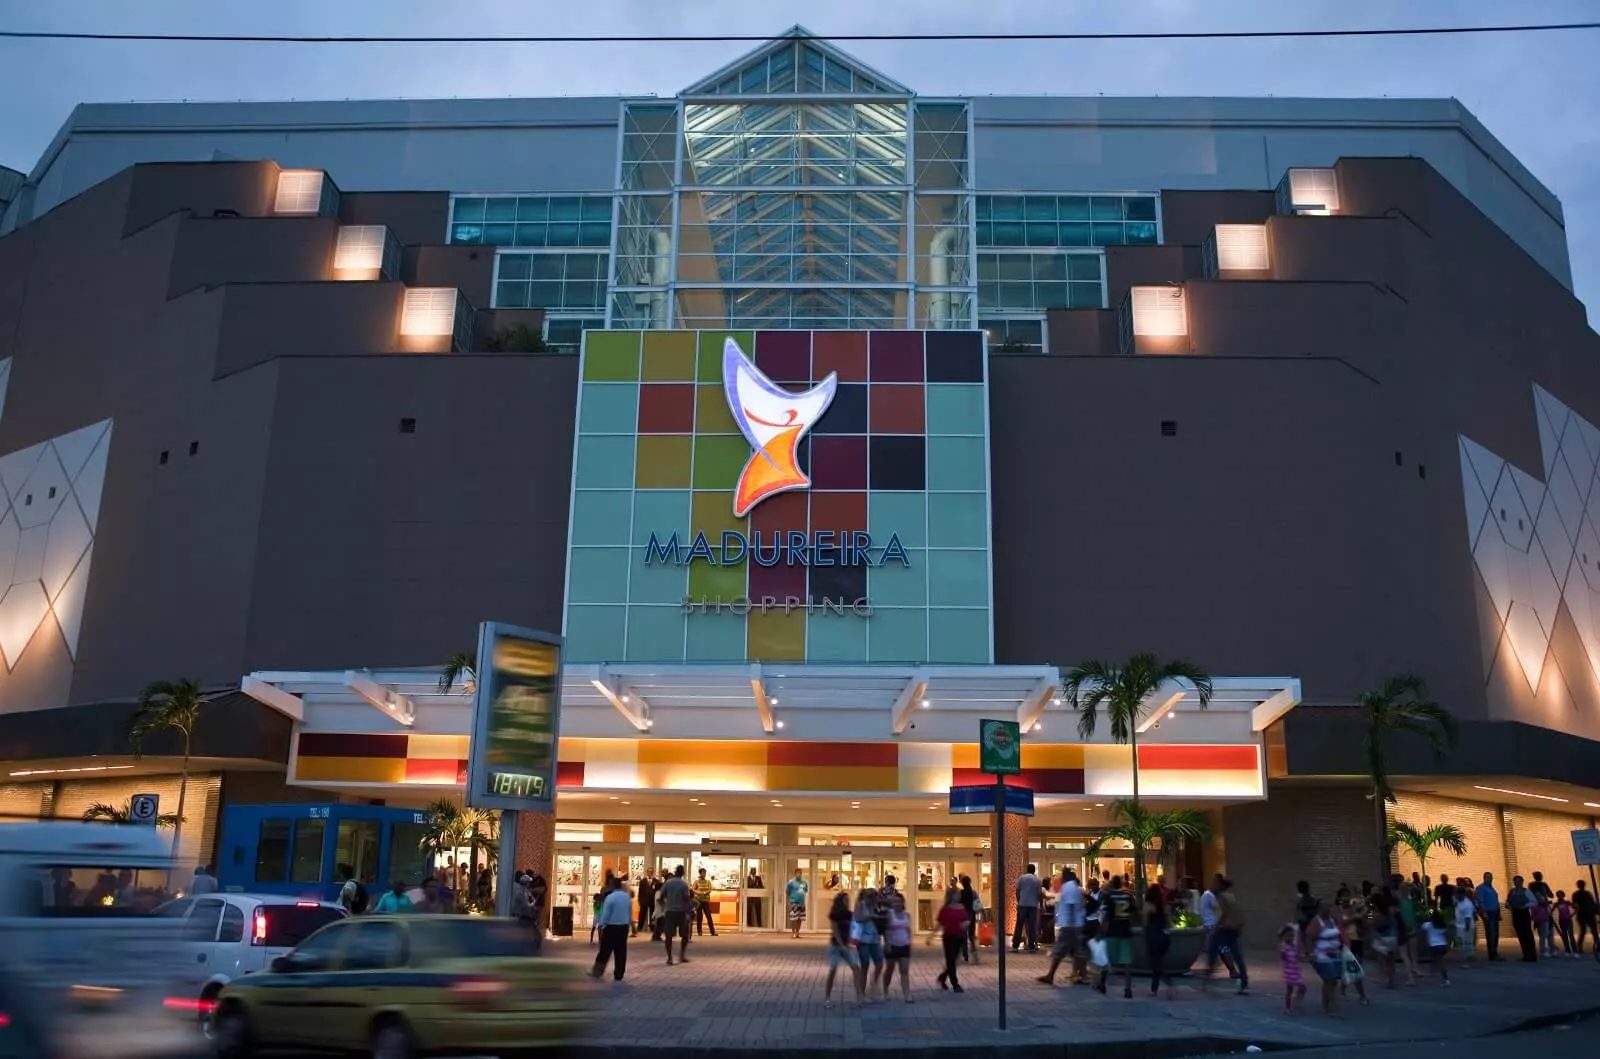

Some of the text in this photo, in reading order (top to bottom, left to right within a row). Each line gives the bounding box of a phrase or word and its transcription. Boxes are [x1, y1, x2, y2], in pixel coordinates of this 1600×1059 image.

[644, 529, 911, 568] MADUREIRA
[680, 594, 874, 618] SHOPPING
[493, 772, 544, 797] 18:19
